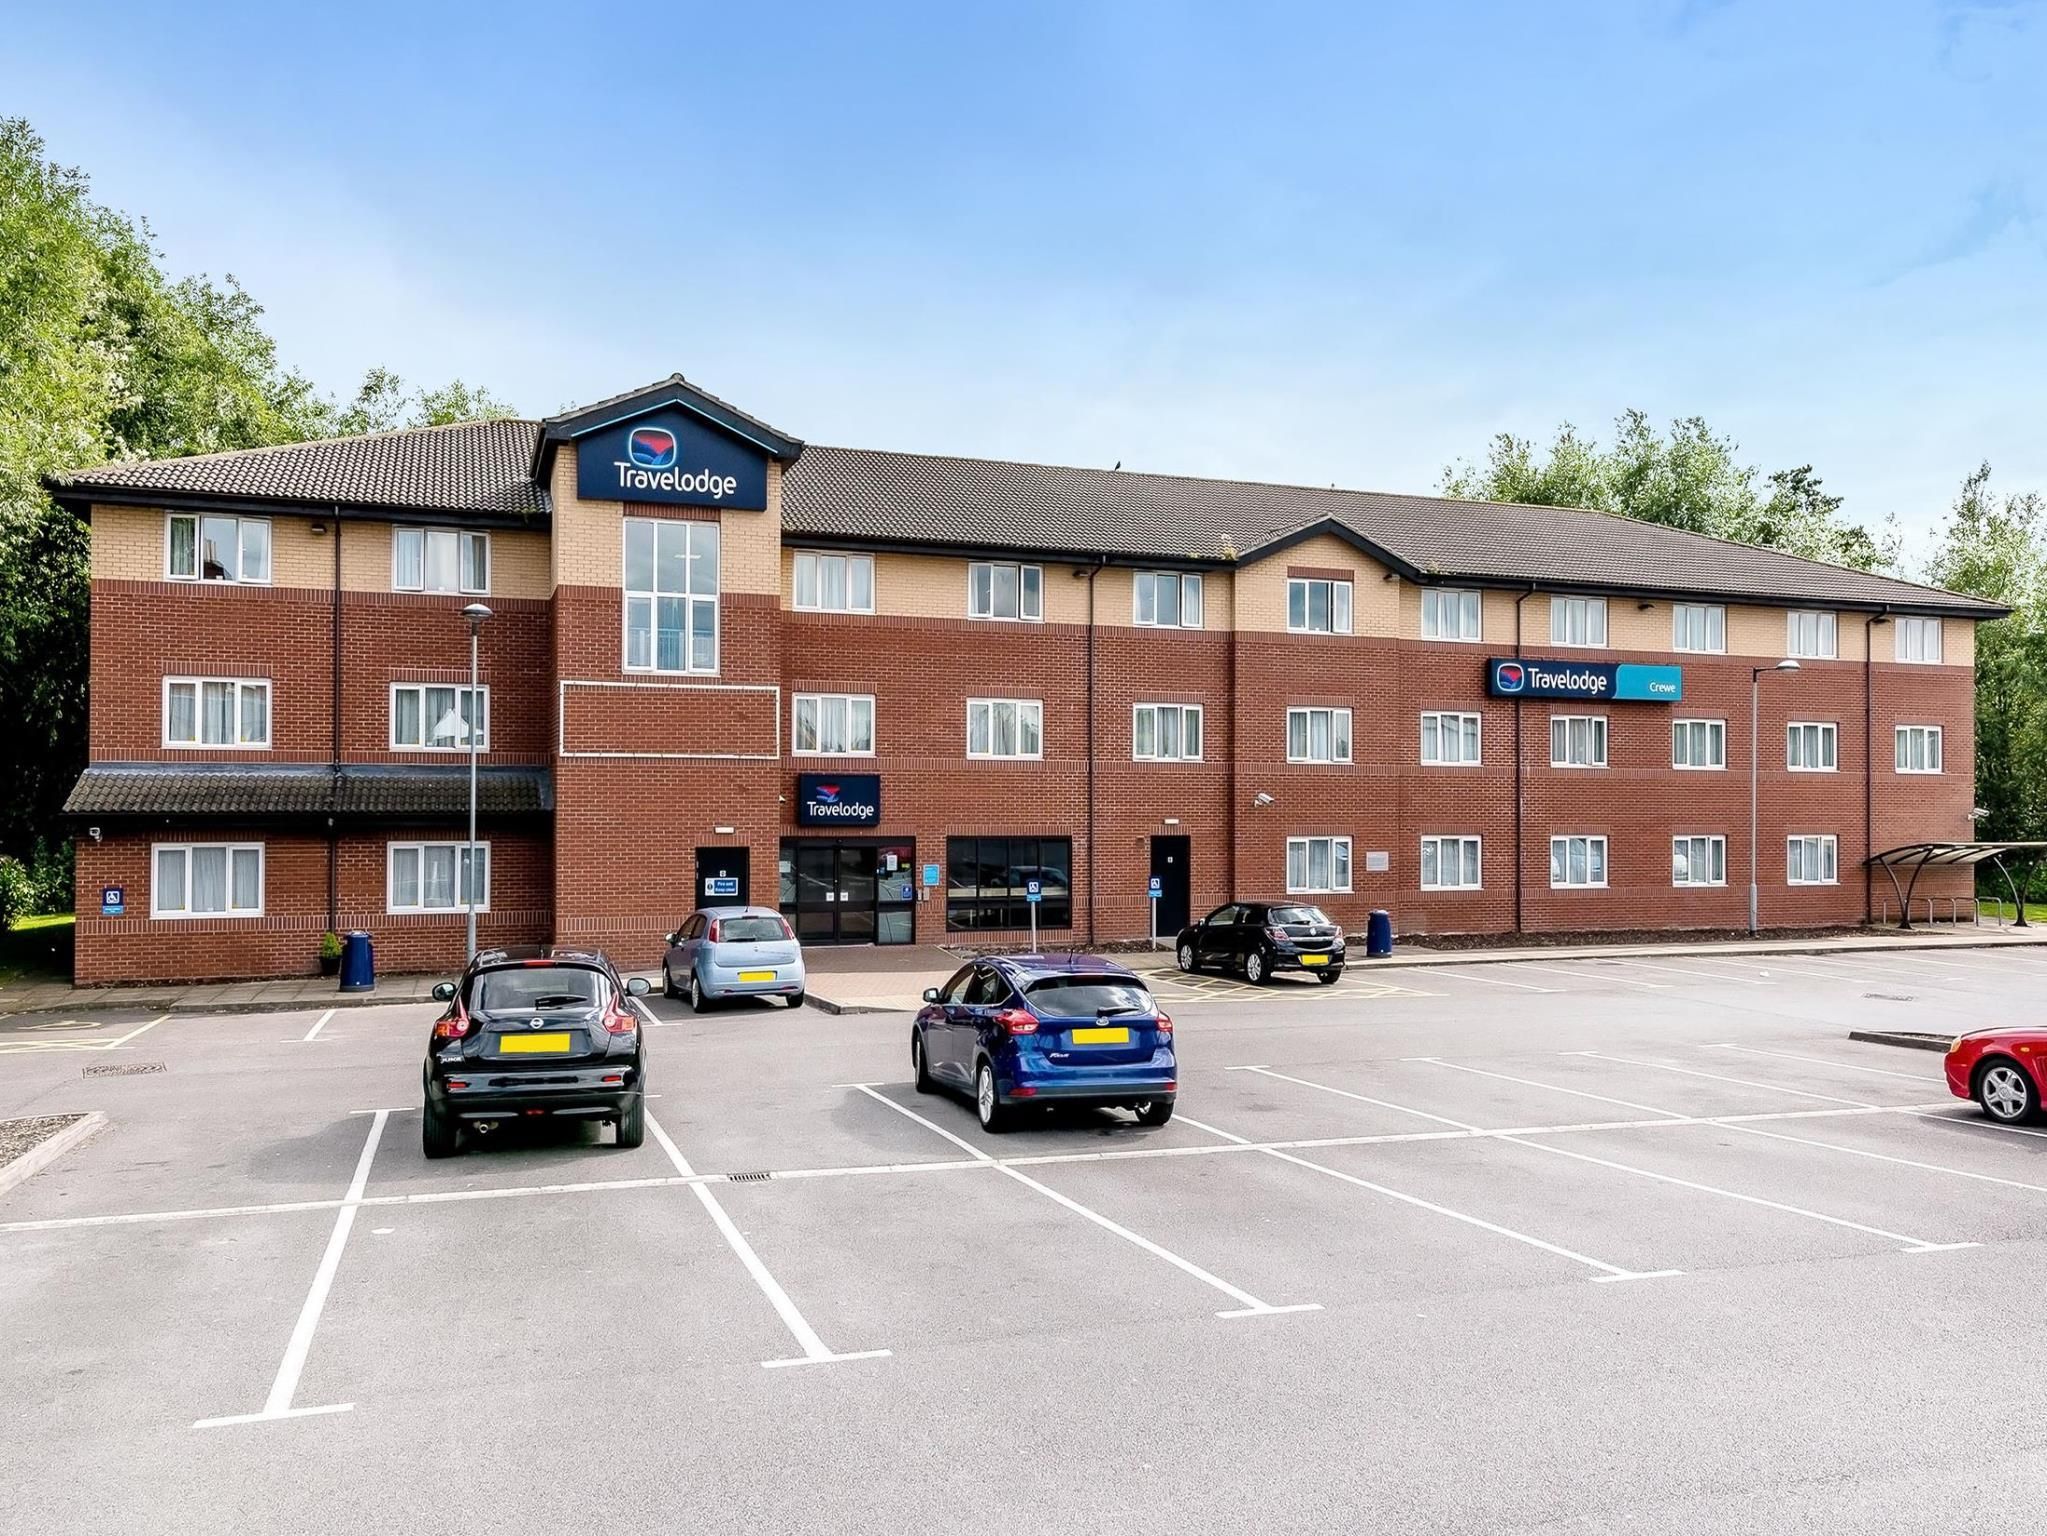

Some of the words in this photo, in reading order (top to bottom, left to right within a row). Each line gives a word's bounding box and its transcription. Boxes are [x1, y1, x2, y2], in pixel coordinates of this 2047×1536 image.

[613, 461, 737, 499] Travelodge
[1527, 667, 1607, 694] Travelodge
[1649, 682, 1676, 693] Crewe
[806, 801, 874, 819] Travelodge
